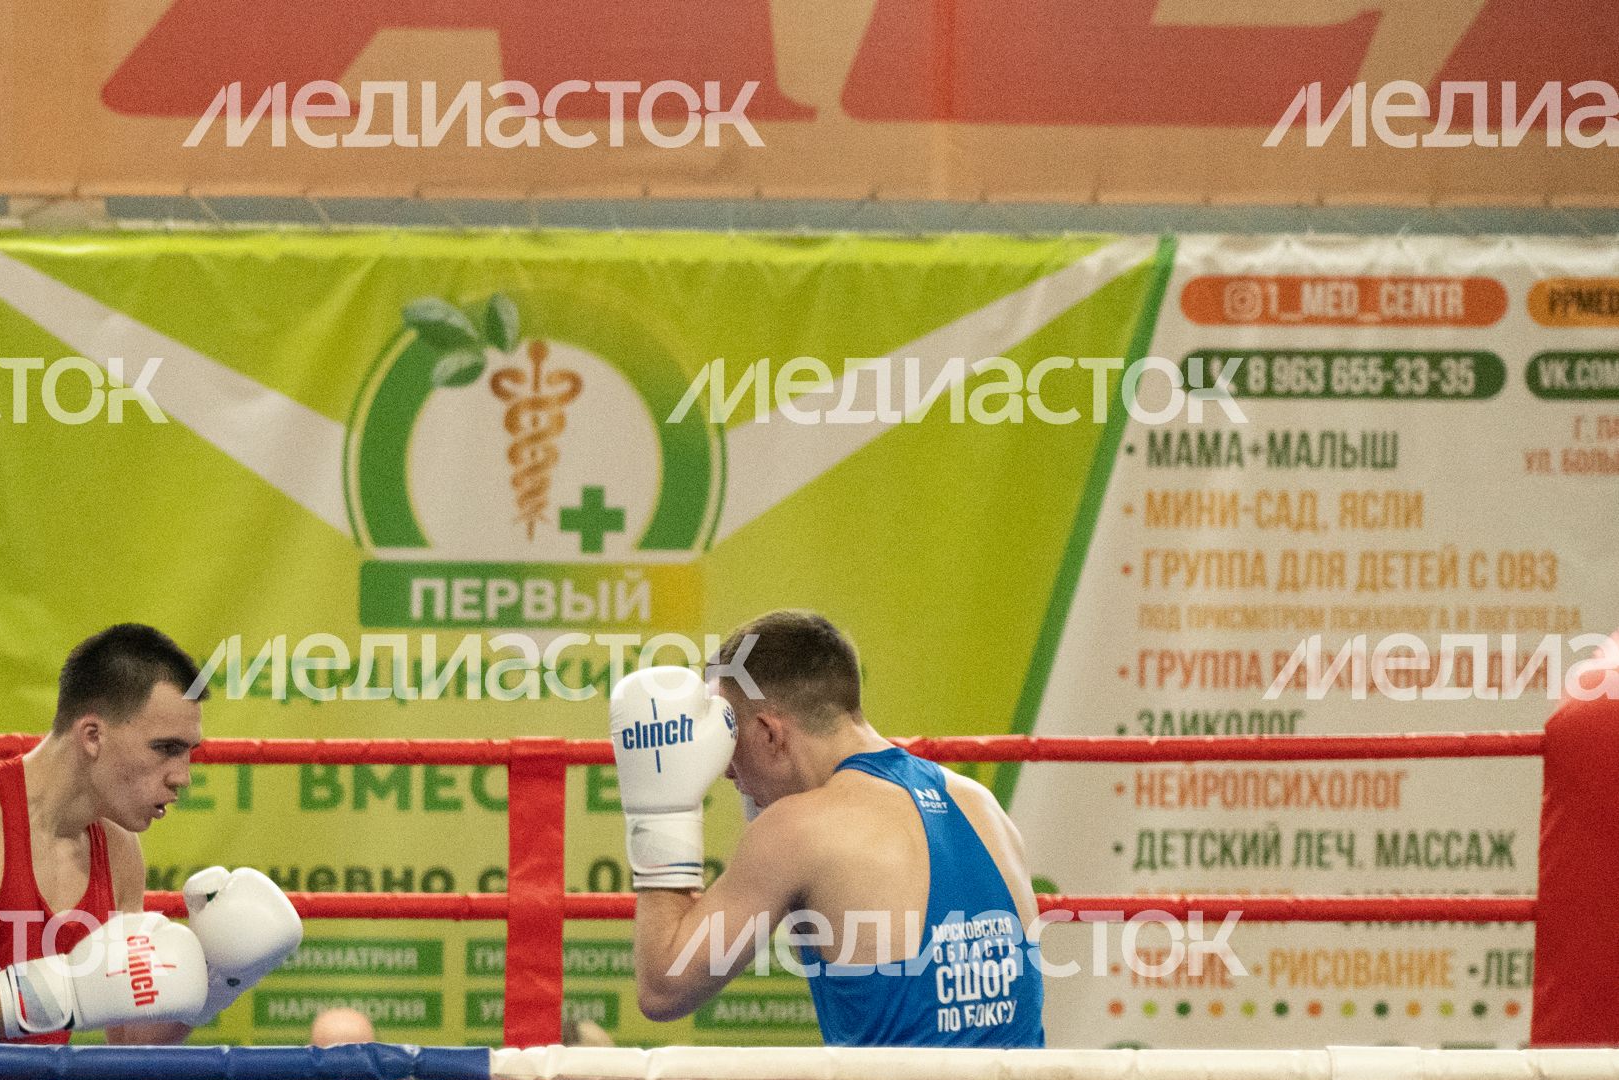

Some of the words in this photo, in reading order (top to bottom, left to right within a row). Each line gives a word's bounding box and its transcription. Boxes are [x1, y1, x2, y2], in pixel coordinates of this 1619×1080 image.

[1247, 355, 1268, 394] 8
[1271, 355, 1326, 395] 963
[1146, 430, 1399, 471] МАМА+МАЛЫШ
[1338, 490, 1424, 530] ЯСЛИ
[1141, 547, 1268, 592] ГРУППА
[1275, 548, 1348, 594] ДЛЯ
[1355, 544, 1460, 594] ДЕТЕЙ
[410, 568, 652, 623] ПЕРВЫЙ
[1137, 648, 1264, 690] ГРУППА
[622, 713, 694, 751] clinch
[1133, 763, 1409, 810] НЕЙРОПСИХОЛОГ
[1132, 822, 1281, 872] ДЕТСКИЙ
[1375, 829, 1517, 870] МАССАЖ
[932, 917, 1013, 943] МОСКОВСКАЯ
[933, 937, 1016, 964] ОБЛАСТЬ
[126, 934, 160, 1008] clinch
[936, 957, 1017, 1005] СШОР
[1268, 948, 1455, 990] РИСОВАНИЕ
[937, 1007, 961, 1033] ПО
[964, 1000, 1018, 1028] БОКСУ
